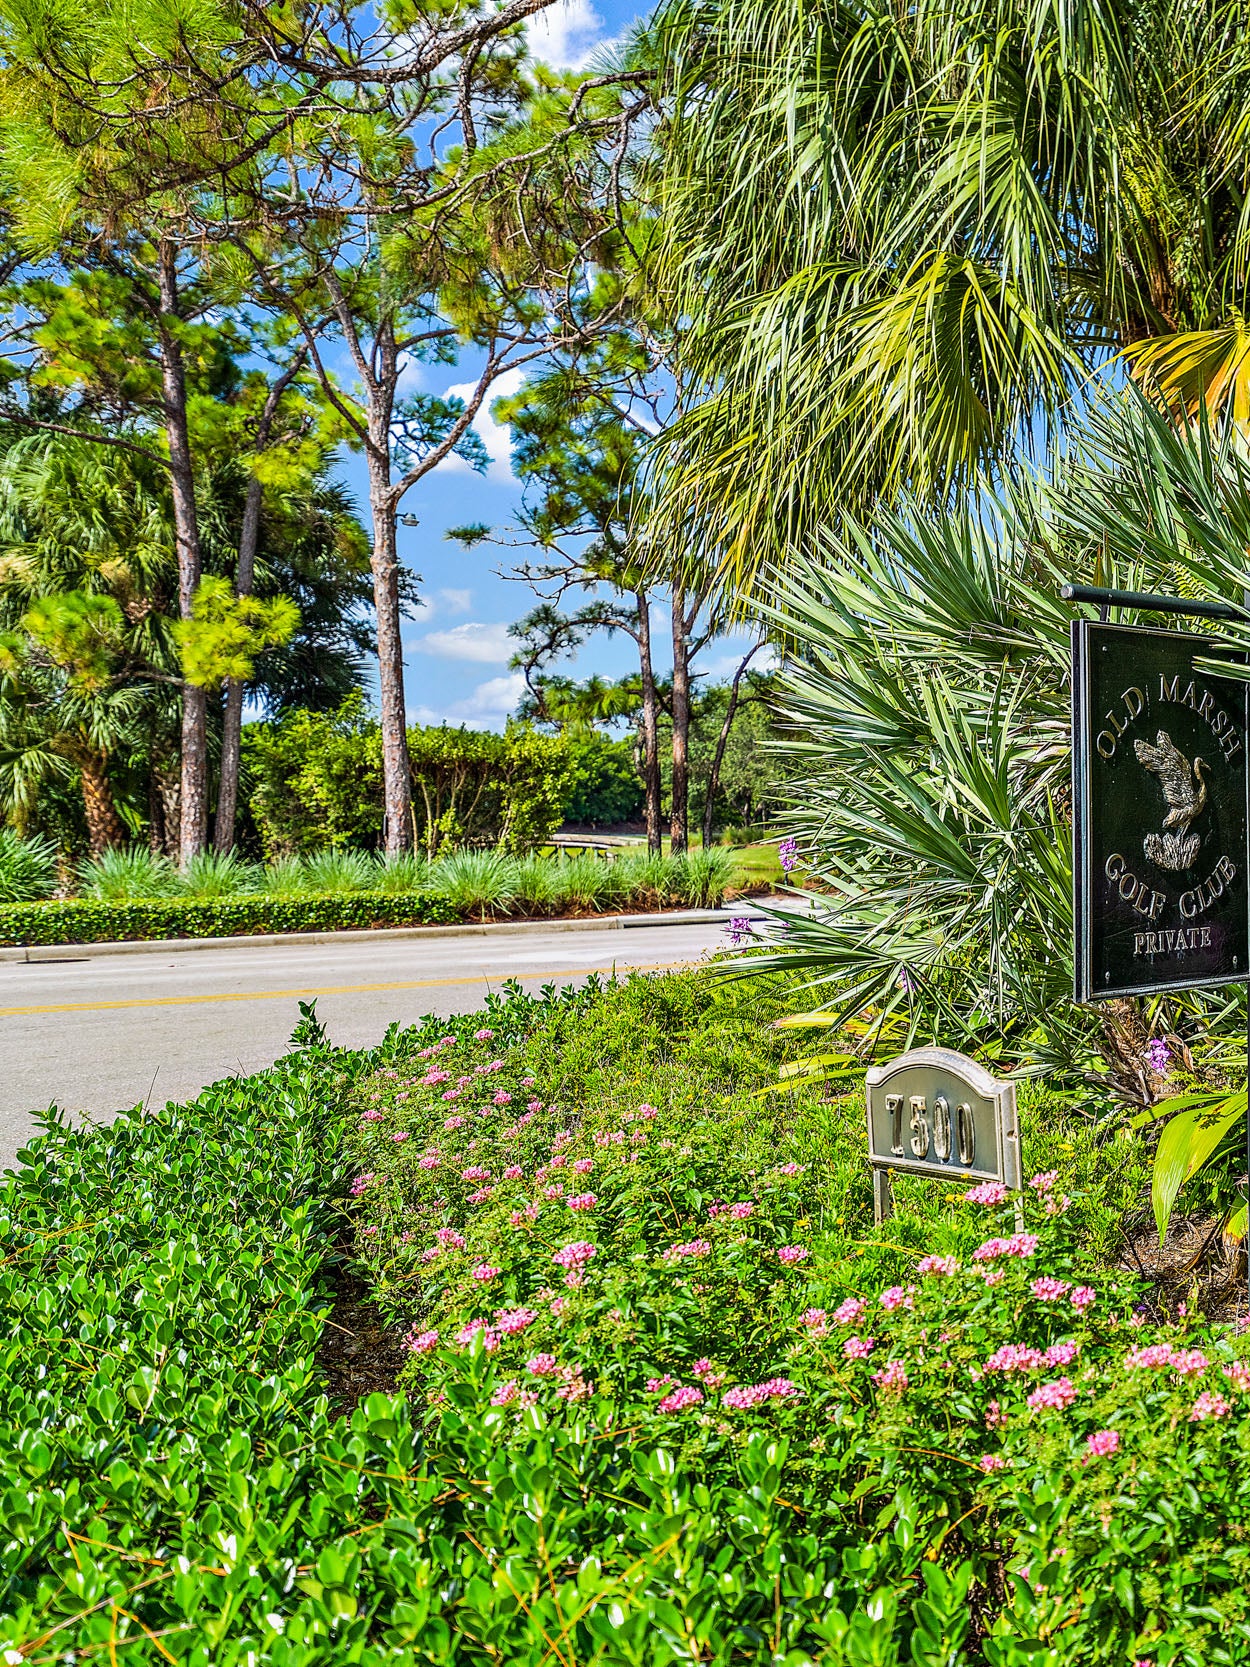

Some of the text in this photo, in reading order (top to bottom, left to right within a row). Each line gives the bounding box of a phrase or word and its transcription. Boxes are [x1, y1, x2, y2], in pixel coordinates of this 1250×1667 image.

[1096, 673, 1242, 763] OLD MARSH
[1105, 853, 1237, 920] GOLF CLUB
[1133, 926, 1212, 955] PRIVATE
[885, 1093, 975, 1165] 7500
